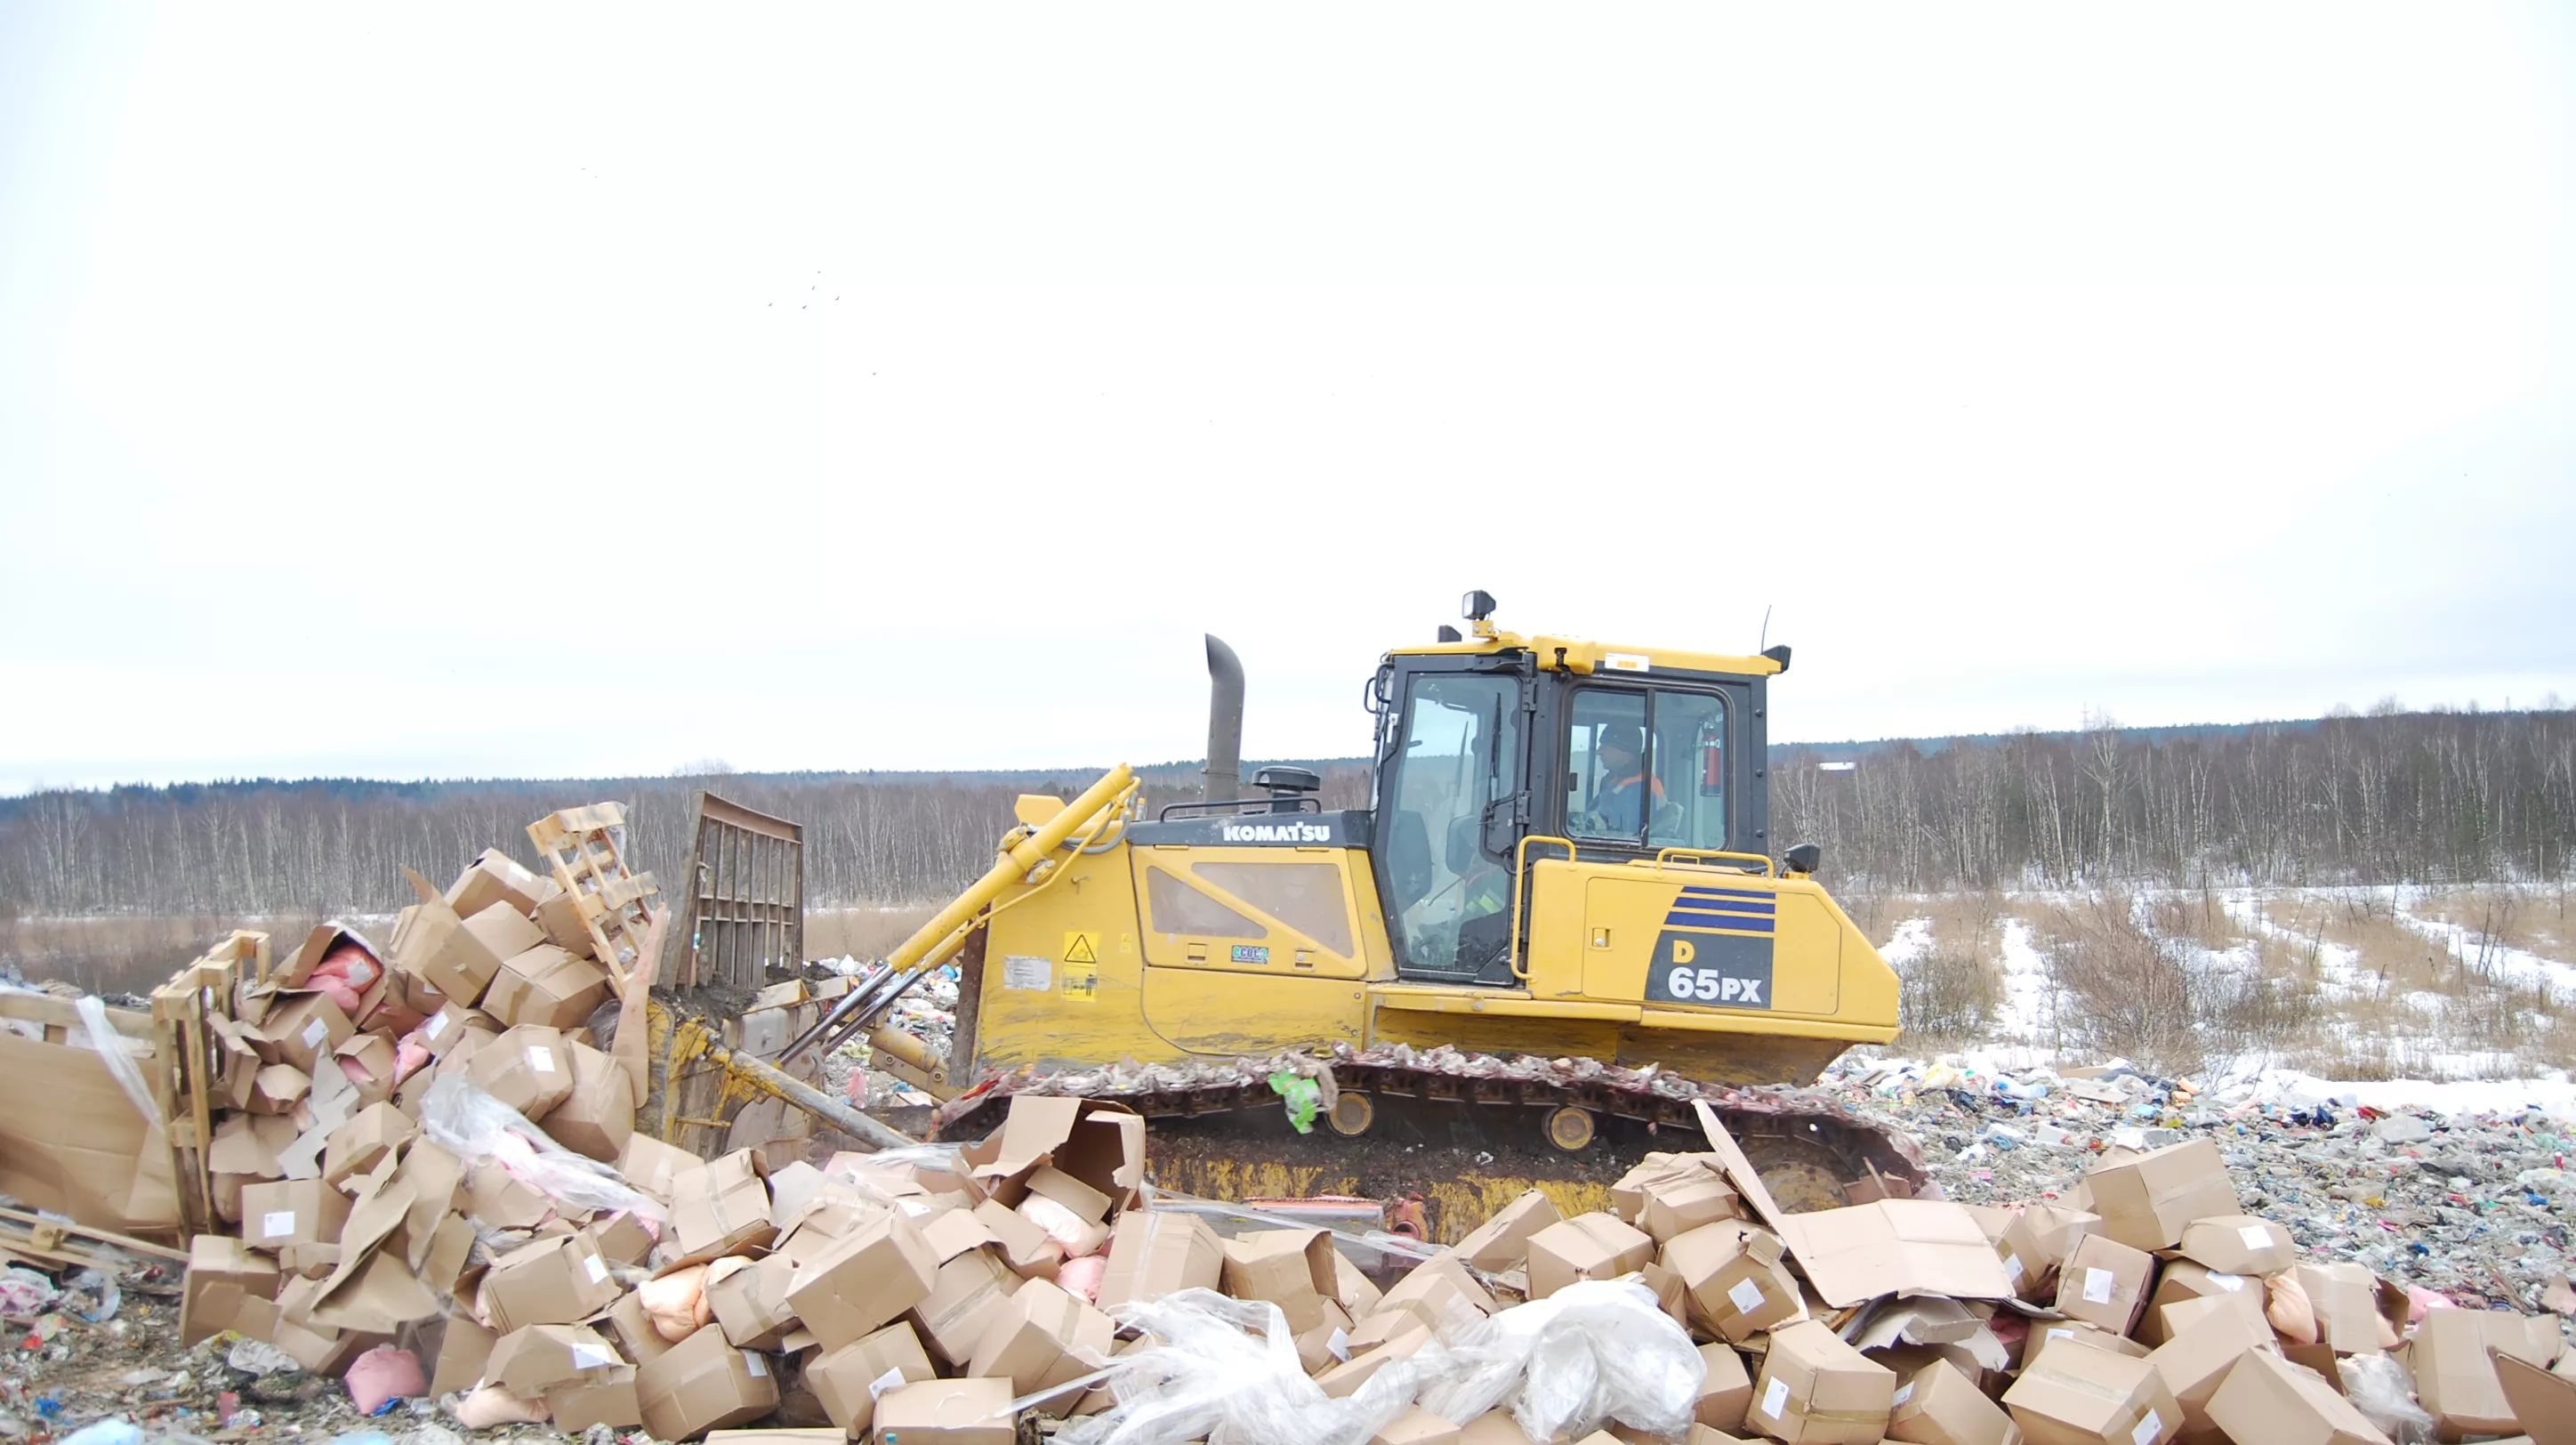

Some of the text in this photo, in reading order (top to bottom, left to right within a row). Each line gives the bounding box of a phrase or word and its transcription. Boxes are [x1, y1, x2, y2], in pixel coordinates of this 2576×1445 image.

[1223, 821, 1331, 842] KOMATSU
[1673, 940, 1695, 964] D
[1669, 966, 1762, 1003] 65PX
